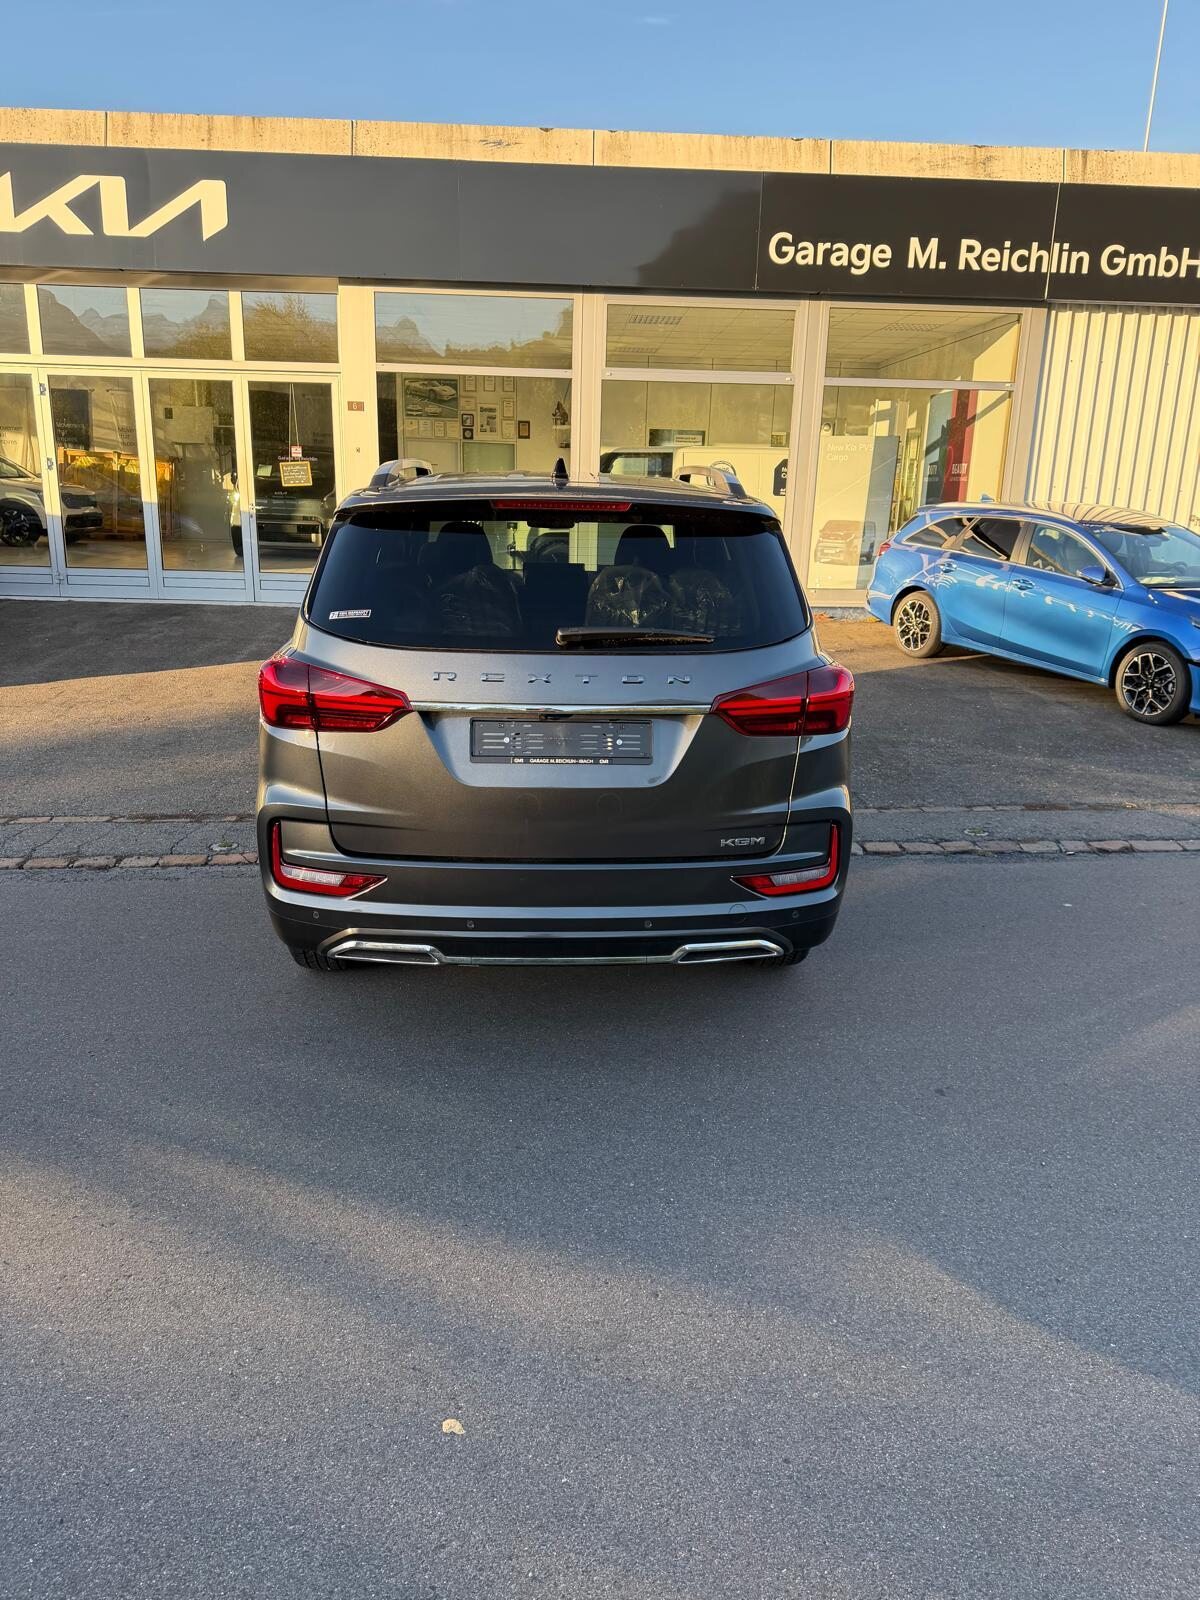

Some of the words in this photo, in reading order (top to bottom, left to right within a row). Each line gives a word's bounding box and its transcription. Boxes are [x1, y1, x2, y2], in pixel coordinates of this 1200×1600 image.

[0, 171, 228, 242] KIA
[768, 231, 892, 275] Garage
[907, 236, 946, 270] M.
[958, 238, 1090, 275] Reichlin
[1100, 244, 1200, 279] GmbH
[432, 670, 692, 685] REXTON
[720, 836, 766, 848] KGM
